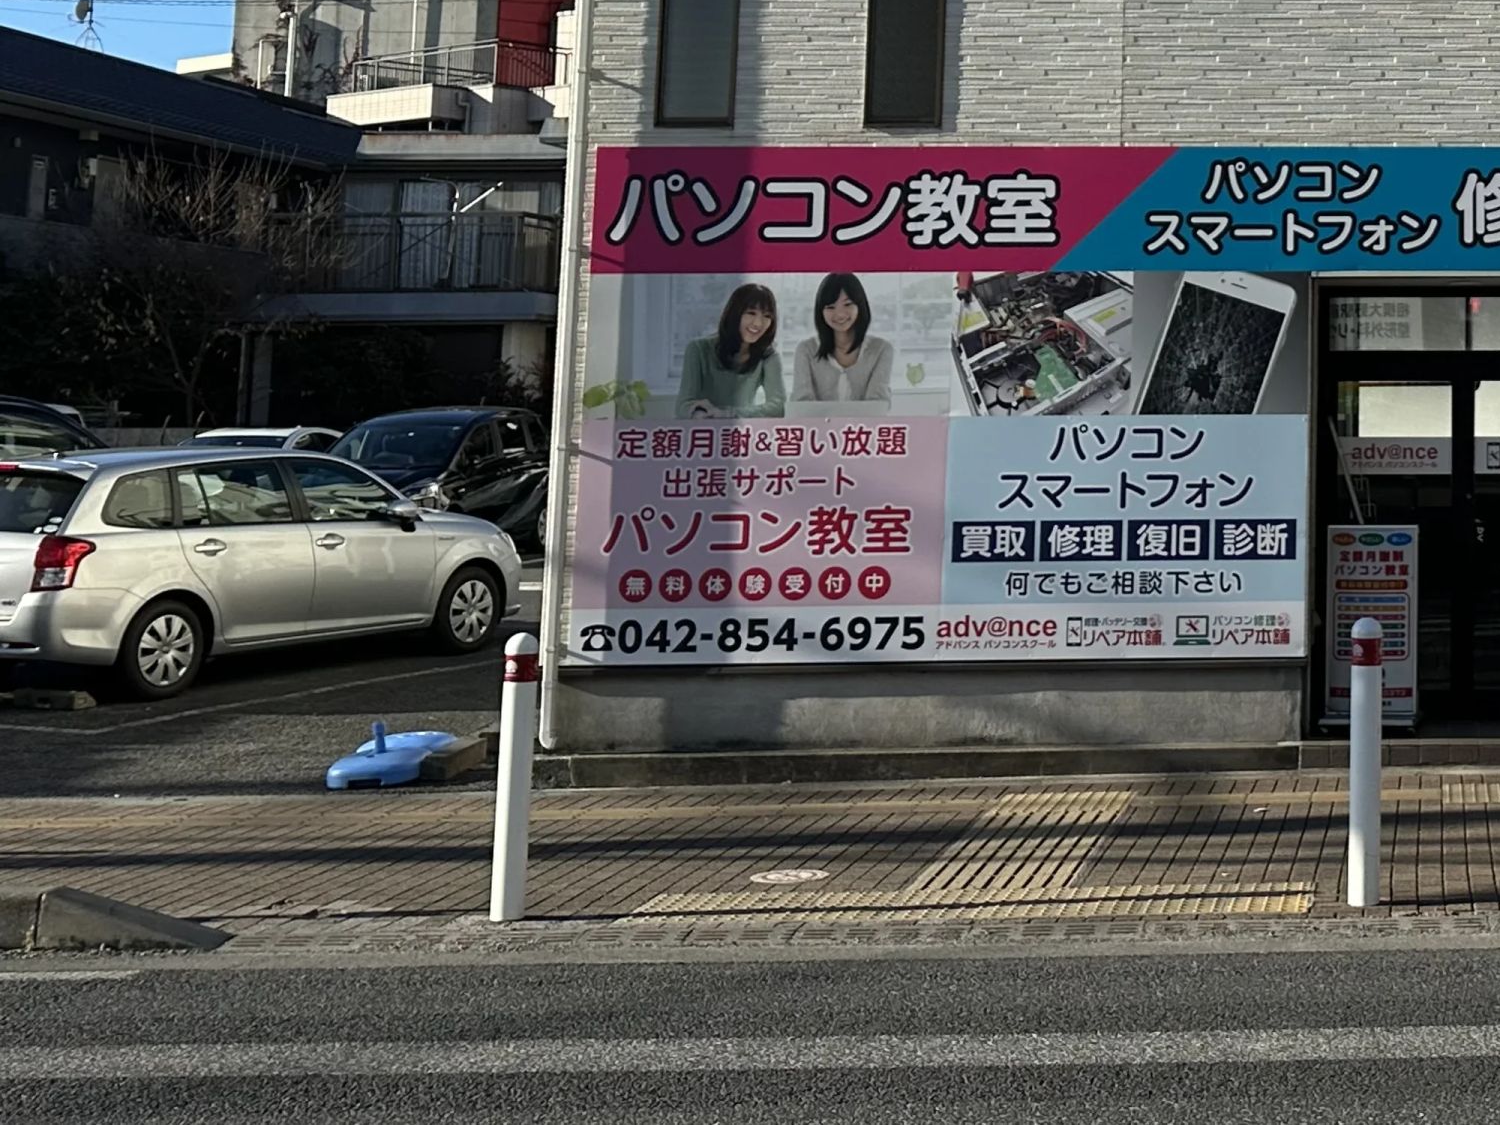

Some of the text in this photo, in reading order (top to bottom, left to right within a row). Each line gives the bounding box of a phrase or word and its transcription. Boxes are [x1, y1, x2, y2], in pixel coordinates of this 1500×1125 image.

[1203, 162, 1382, 204] パソコン
[607, 172, 1060, 248] パソコン教室
[1144, 211, 1441, 256] スマートフォン
[617, 426, 908, 458] 定額月謝&習い放題
[1049, 424, 1205, 462] パソコン
[1351, 443, 1438, 460] adv@nce
[662, 467, 857, 499] 出張サポート
[996, 472, 1255, 509] スマートフォン
[602, 506, 912, 557] パソコン教室
[961, 524, 1289, 558] 買取 修理 復旧 診断
[622, 571, 887, 599] 無料体験受付中
[1005, 572, 1243, 597] 何でもご相談下さい
[617, 616, 925, 654] 042-854-6975
[936, 614, 1057, 639] adv@nce
[1083, 629, 1163, 647] リペア本舗
[1212, 628, 1290, 645] リペア本舗
